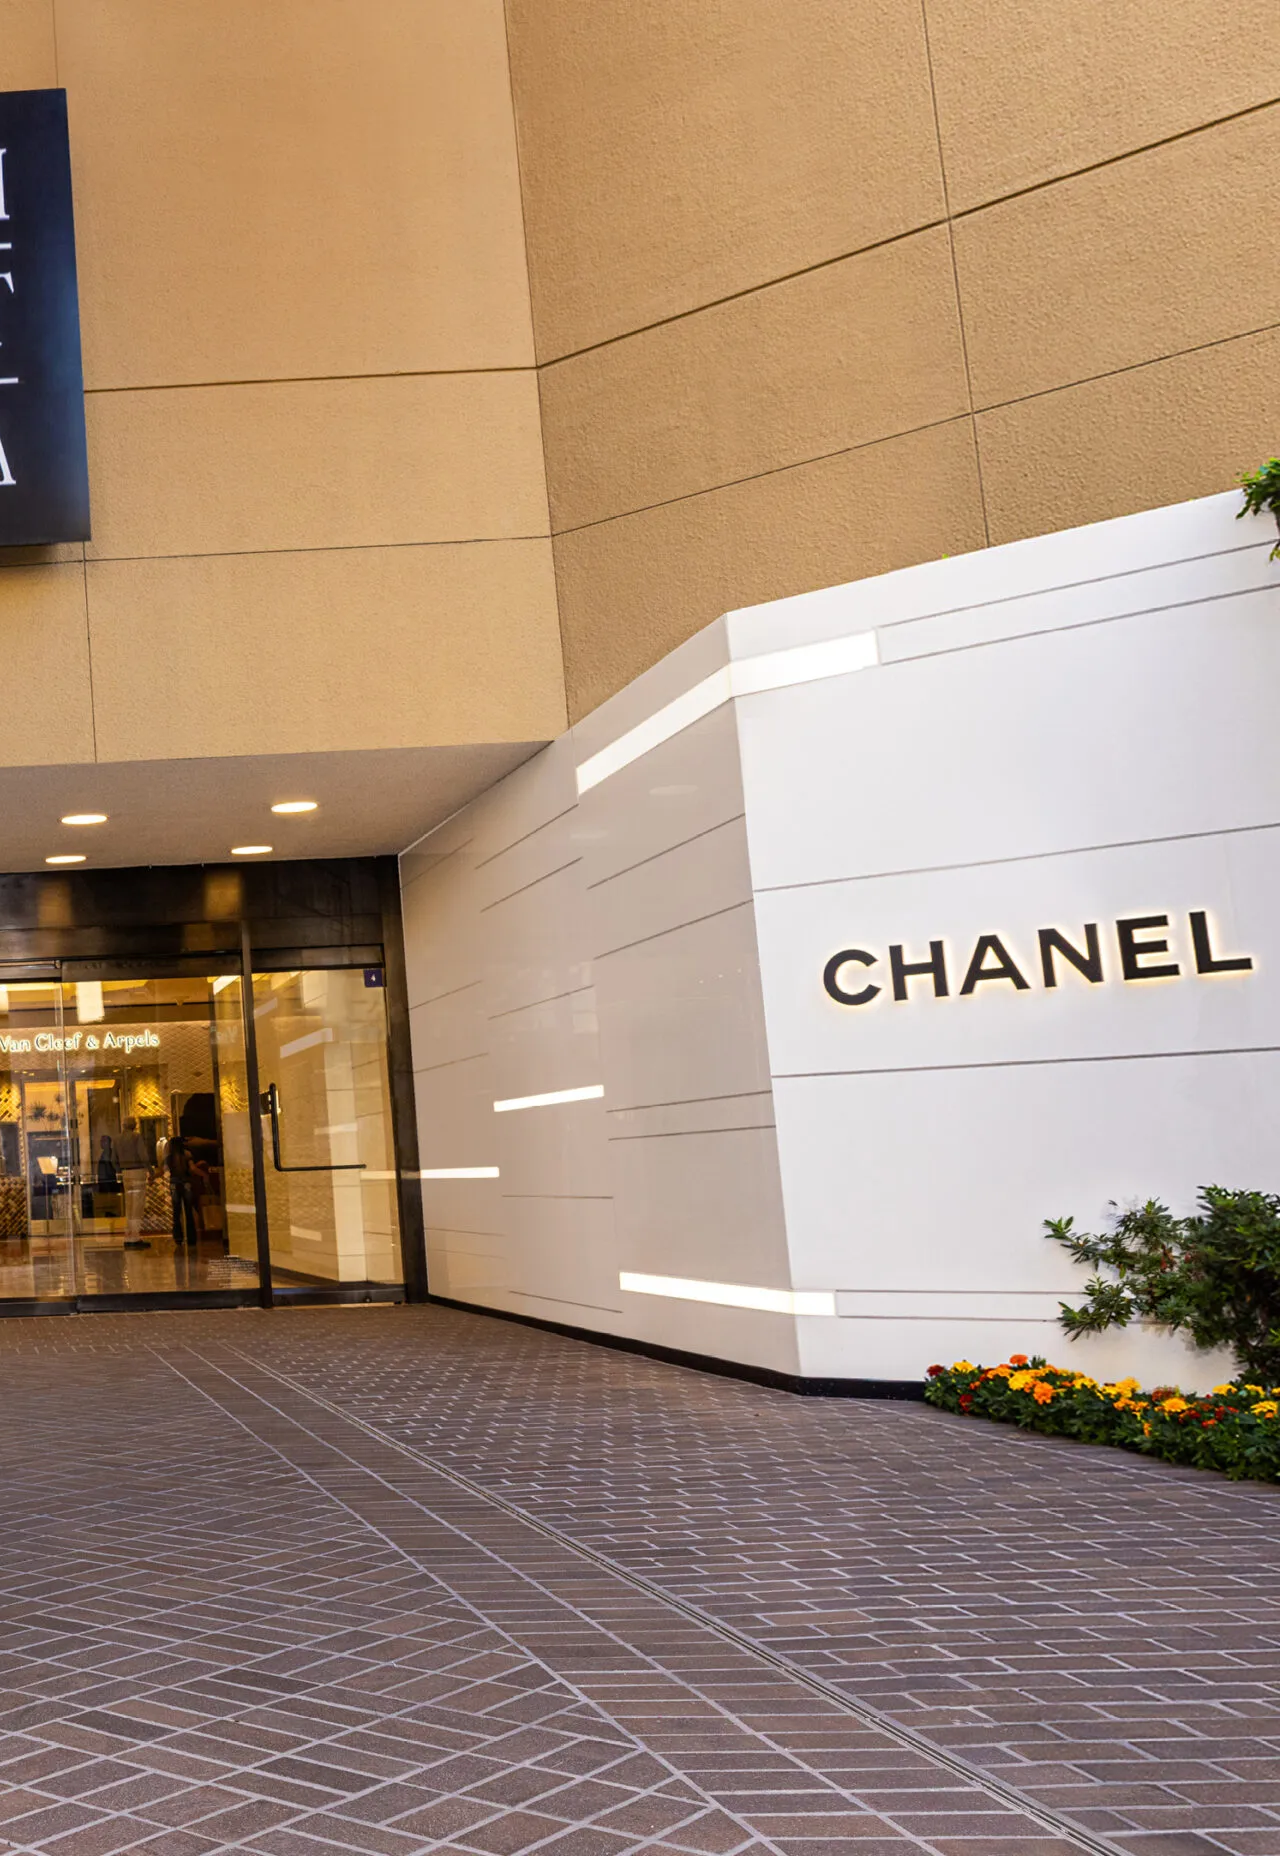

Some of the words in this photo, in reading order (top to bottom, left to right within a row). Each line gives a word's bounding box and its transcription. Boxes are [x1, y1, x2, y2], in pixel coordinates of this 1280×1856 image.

[822, 910, 1254, 1006] CHANEL
[35, 1032, 82, 1051] Cleef
[86, 1035, 100, 1050] &
[103, 1029, 160, 1054] Arpels
